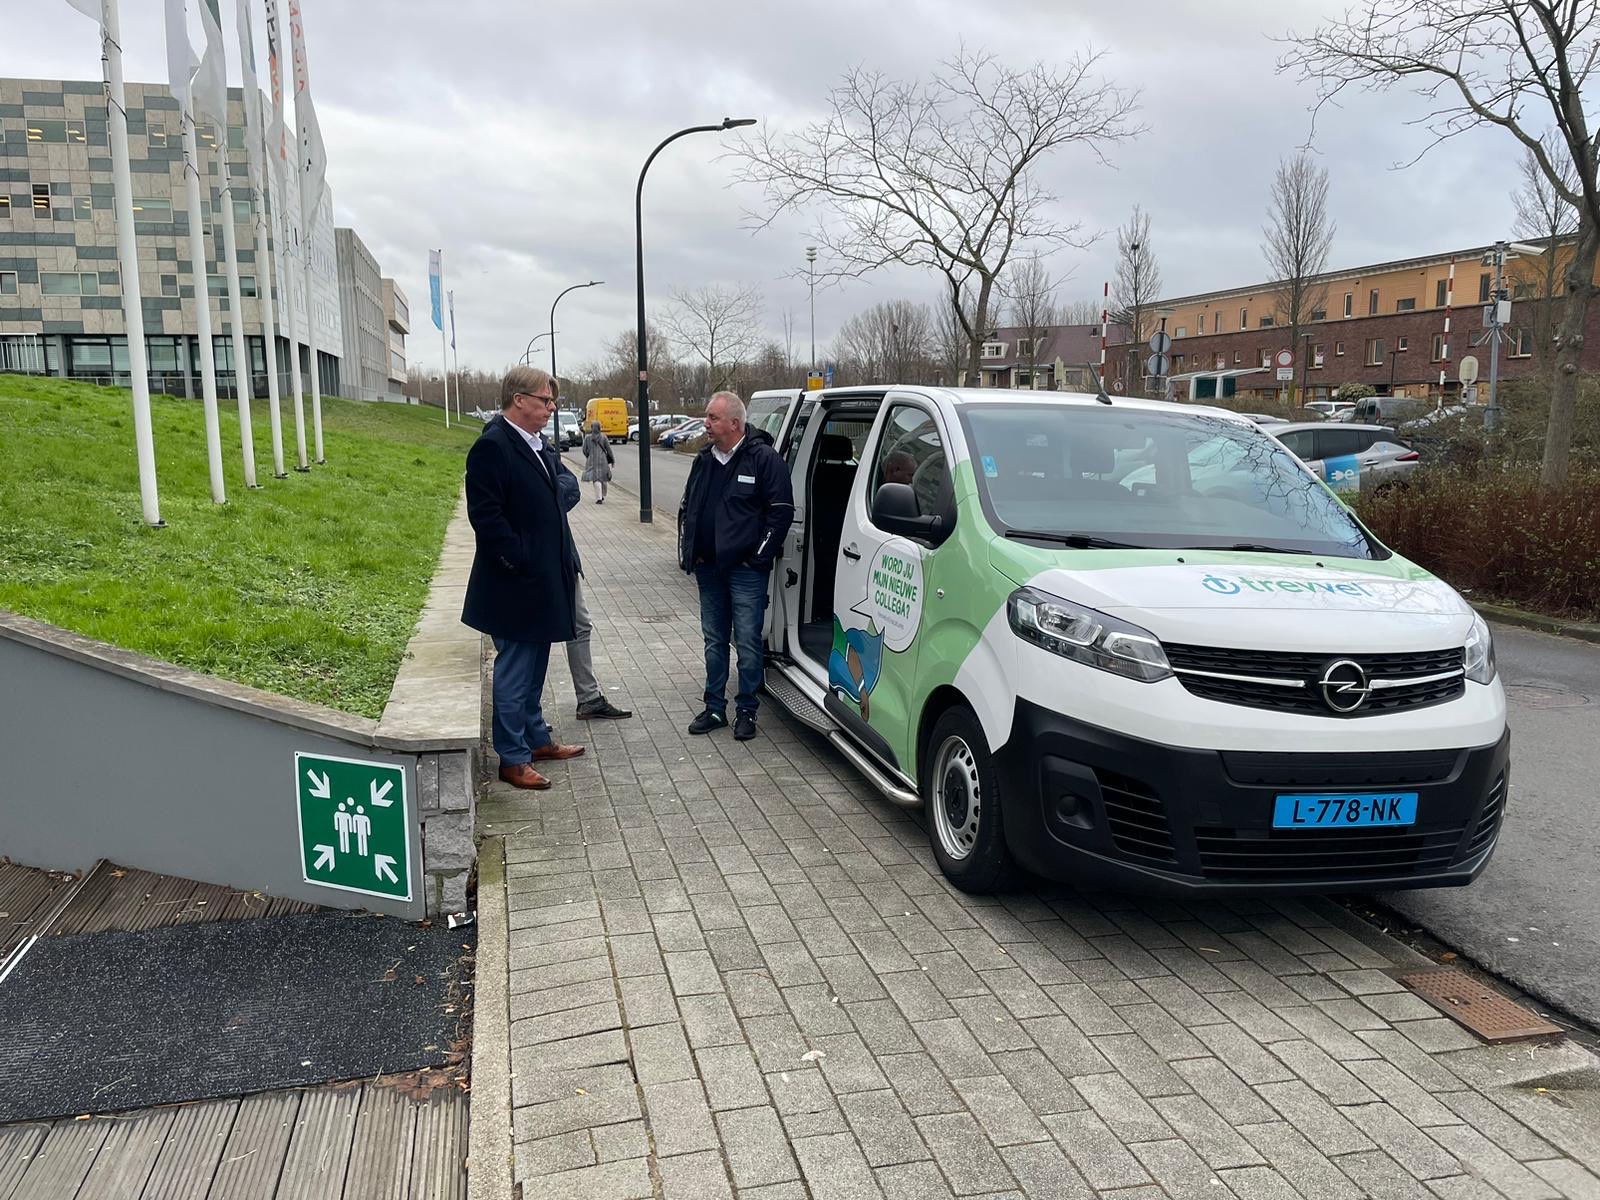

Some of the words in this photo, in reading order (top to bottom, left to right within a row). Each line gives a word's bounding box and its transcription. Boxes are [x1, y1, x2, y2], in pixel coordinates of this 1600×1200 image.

[881, 554, 903, 575] WORD
[902, 563, 915, 580] JIJ
[873, 569, 890, 590] MIJN
[888, 576, 918, 602] NIEUWE
[874, 590, 911, 619] COLLEGA?
[1292, 798, 1402, 823] L-778-NK
